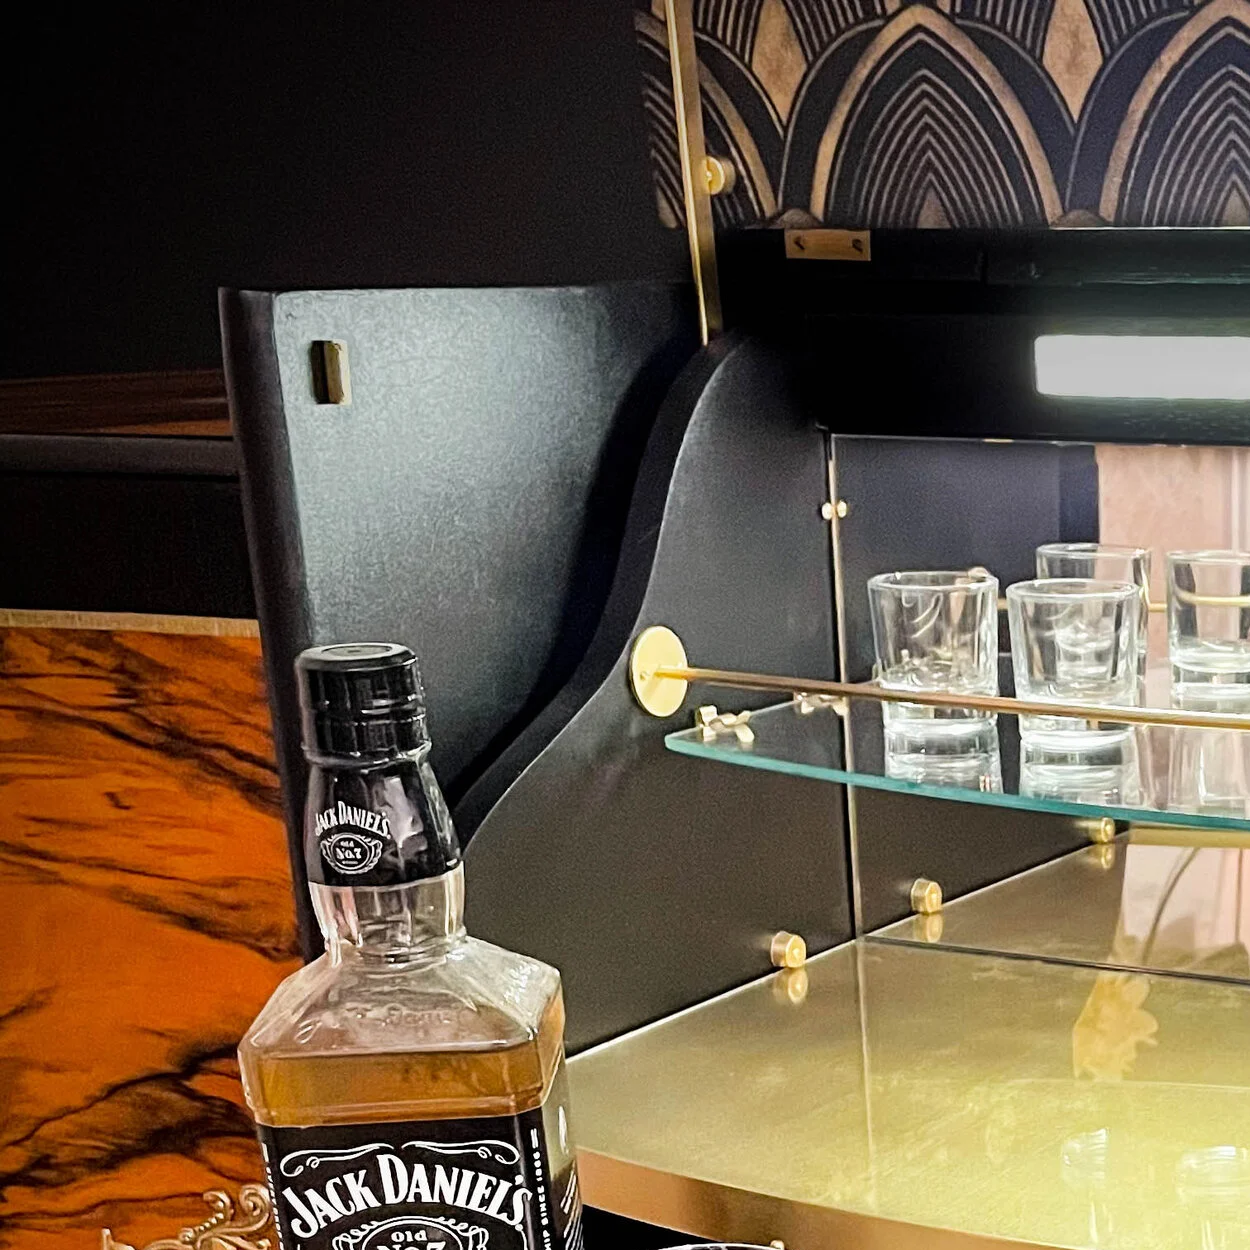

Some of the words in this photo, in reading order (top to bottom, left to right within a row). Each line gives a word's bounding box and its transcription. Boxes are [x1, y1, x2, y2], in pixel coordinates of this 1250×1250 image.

[315, 807, 338, 837] JACK
[282, 1169, 385, 1239] JACK
[377, 1154, 533, 1228] DANIEL'S
[537, 1185, 549, 1226] SINCE
[390, 1229, 428, 1243] Old
